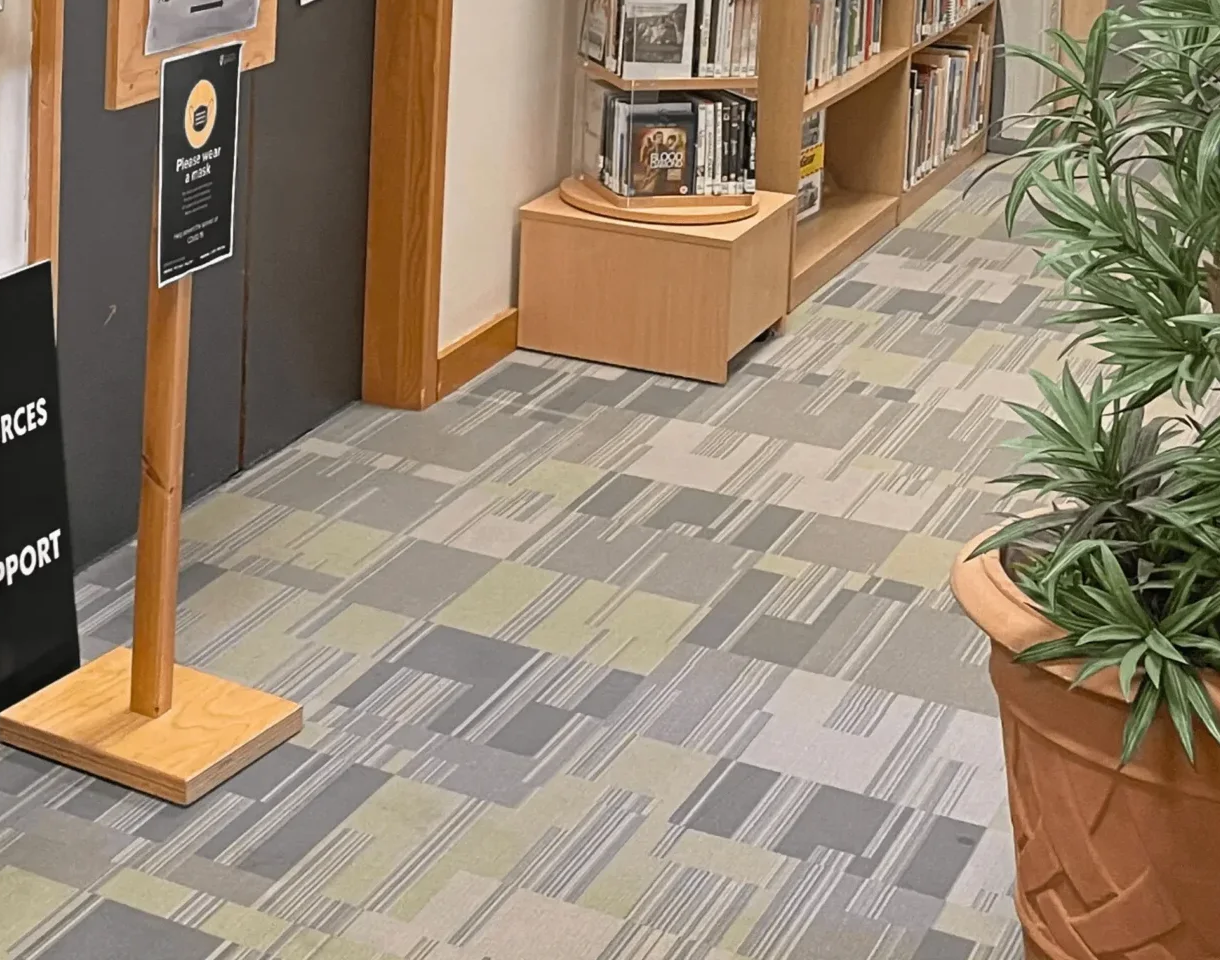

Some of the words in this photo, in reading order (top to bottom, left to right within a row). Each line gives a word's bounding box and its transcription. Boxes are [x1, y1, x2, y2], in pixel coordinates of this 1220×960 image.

[175, 153, 202, 173] Please
[201, 146, 222, 161] wear
[650, 151, 684, 162] BLOOD
[184, 172, 190, 184] a
[191, 162, 212, 181] mask
